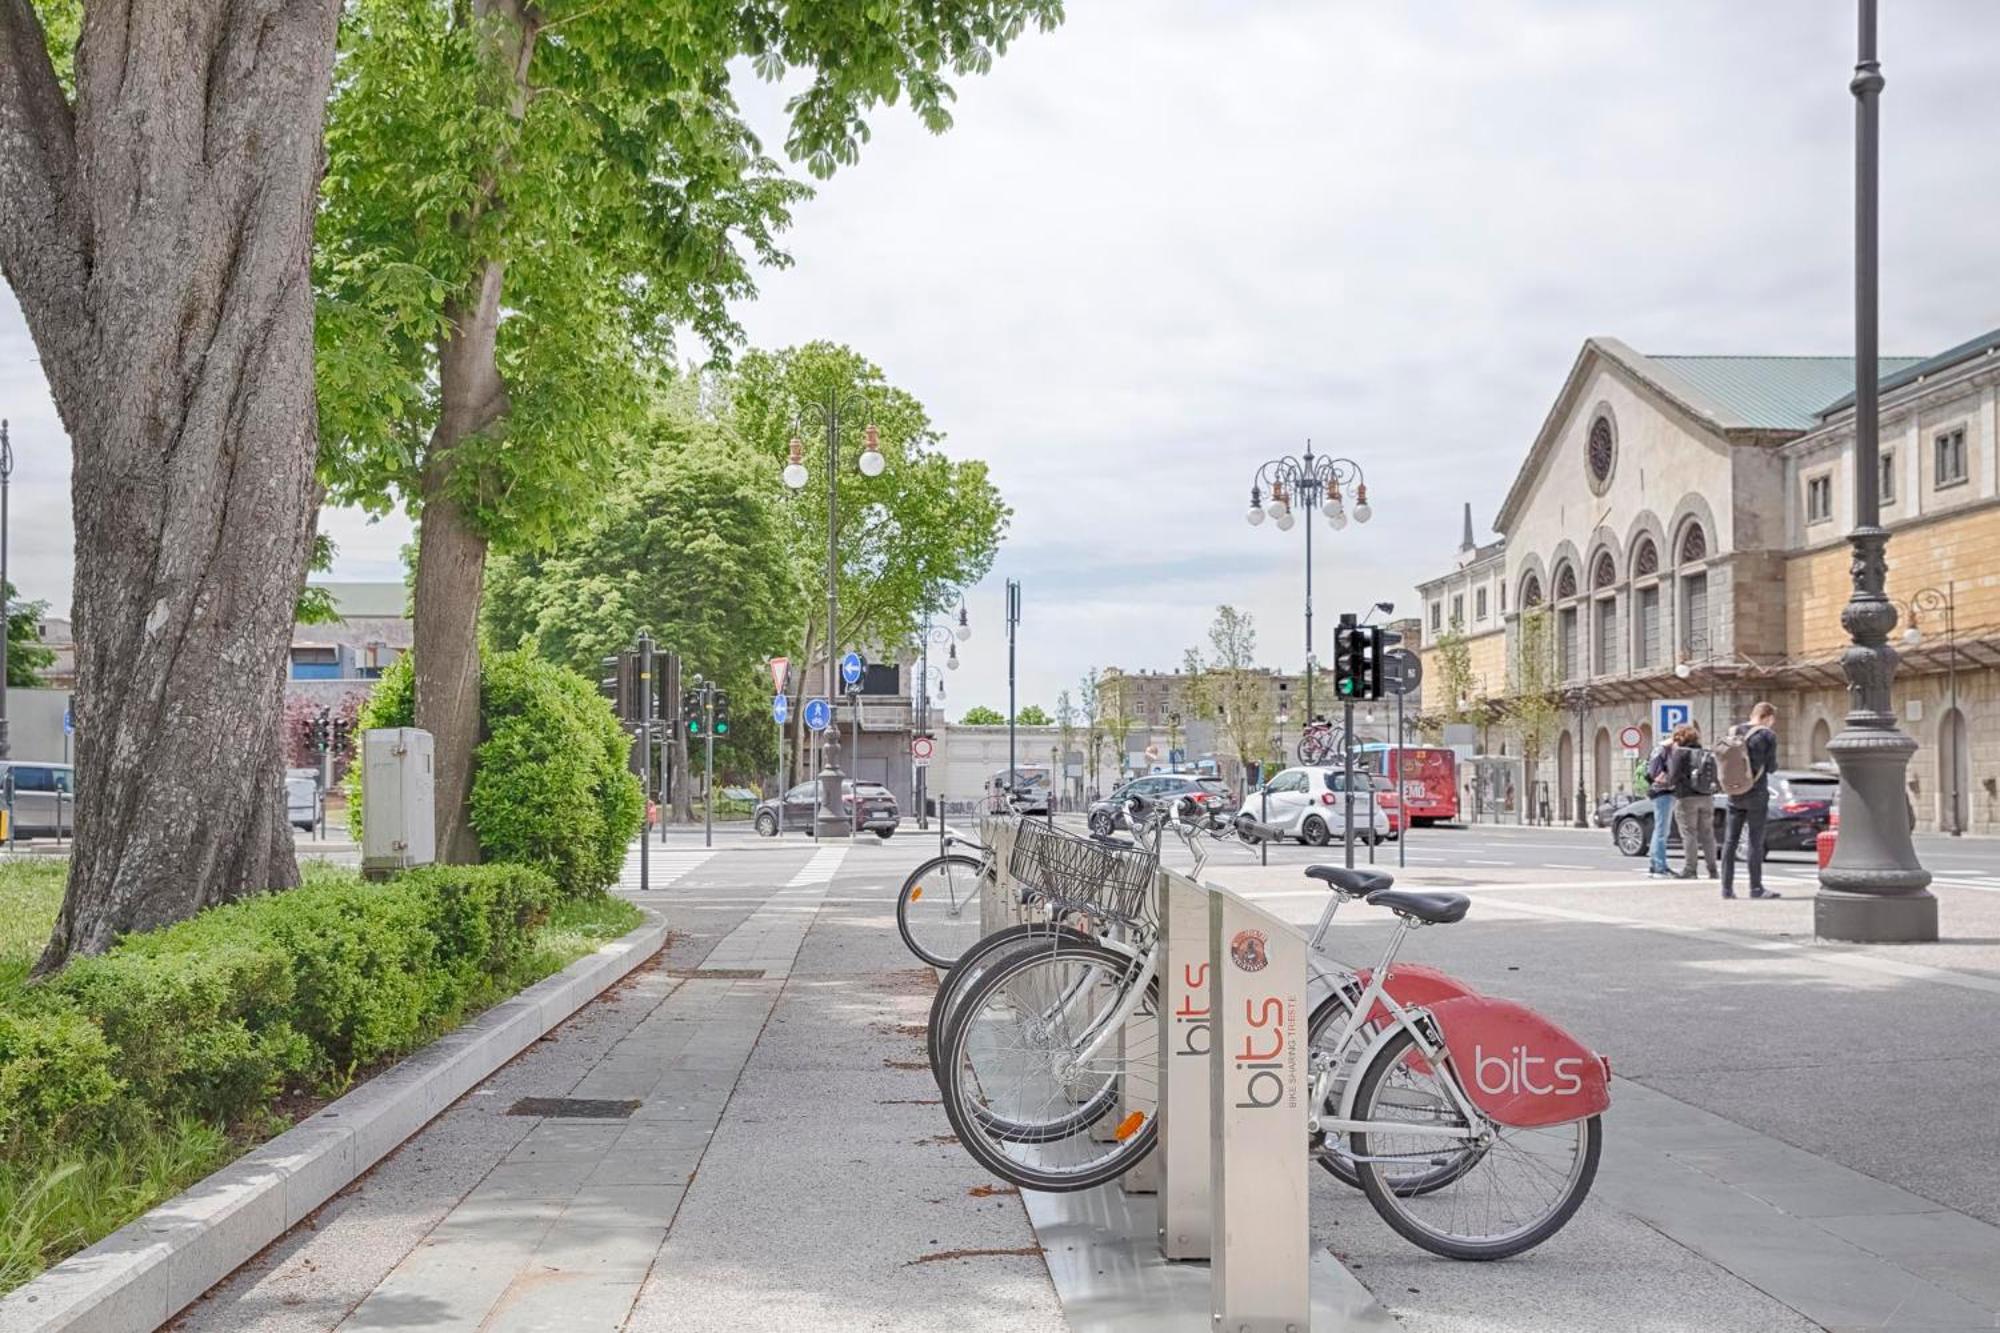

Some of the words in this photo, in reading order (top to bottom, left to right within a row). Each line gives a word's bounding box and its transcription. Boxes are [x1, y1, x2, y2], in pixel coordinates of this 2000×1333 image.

[1667, 708, 1682, 731] P
[1287, 995, 1296, 1037] TRIESTE
[1235, 998, 1283, 1108] bits
[1287, 1040, 1296, 1083] SHARING
[1475, 1045, 1582, 1095] bits
[1287, 1086, 1296, 1108] BIKE
